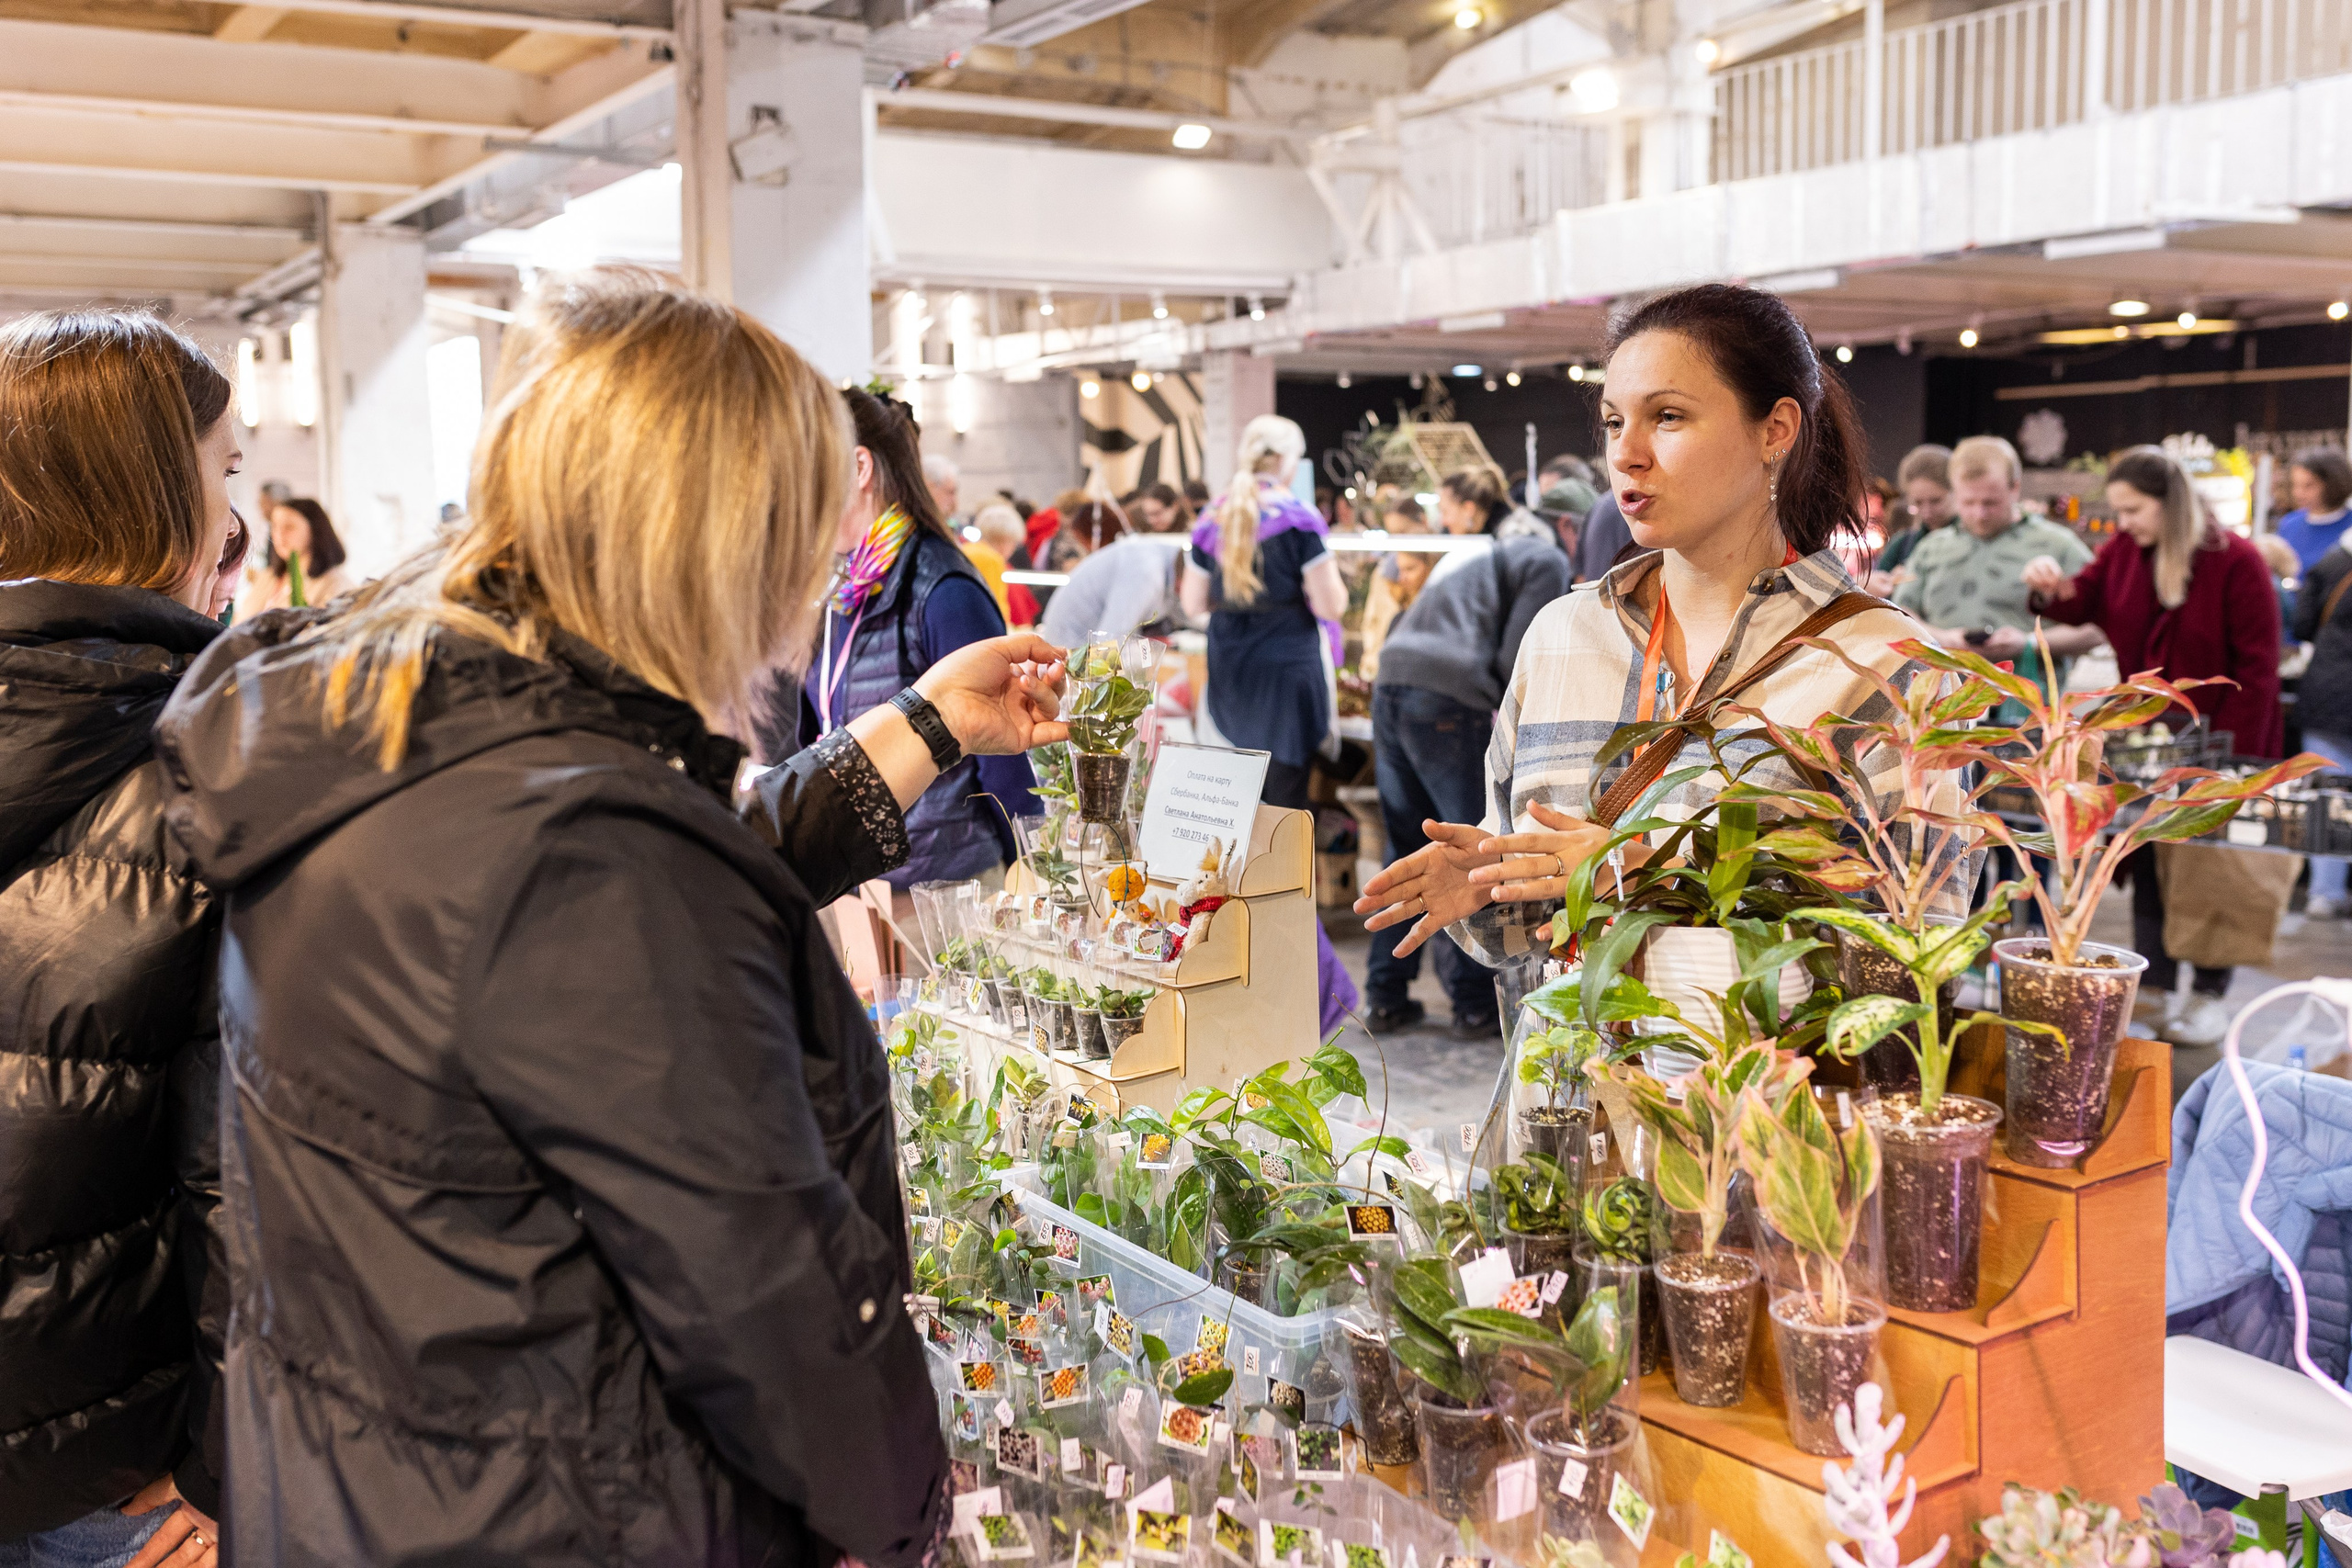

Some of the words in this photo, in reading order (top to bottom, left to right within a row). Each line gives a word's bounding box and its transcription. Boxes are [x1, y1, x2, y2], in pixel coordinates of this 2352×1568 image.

[1187, 770, 1206, 781] Оплата
[1206, 775, 1214, 784] на
[1215, 775, 1232, 787] карту
[1170, 786, 1200, 801] Сбербанка,
[1201, 793, 1238, 808] Альфа-Банка
[1164, 806, 1189, 818] Светлана
[1190, 810, 1228, 826] Анатольевна
[1228, 818, 1235, 828] Х.
[1172, 828, 1180, 836] +7
[1180, 828, 1190, 839] 920
[1191, 829, 1202, 840] 273
[1202, 834, 1209, 842] 46
[960, 980, 968, 992] 500
[920, 1056, 928, 1071] 500
[907, 1146, 916, 1160] 500
[1408, 1154, 1423, 1175] 1500
[927, 1220, 935, 1237] 500
[1040, 1222, 1050, 1240] 650
[919, 1303, 929, 1325] 400
